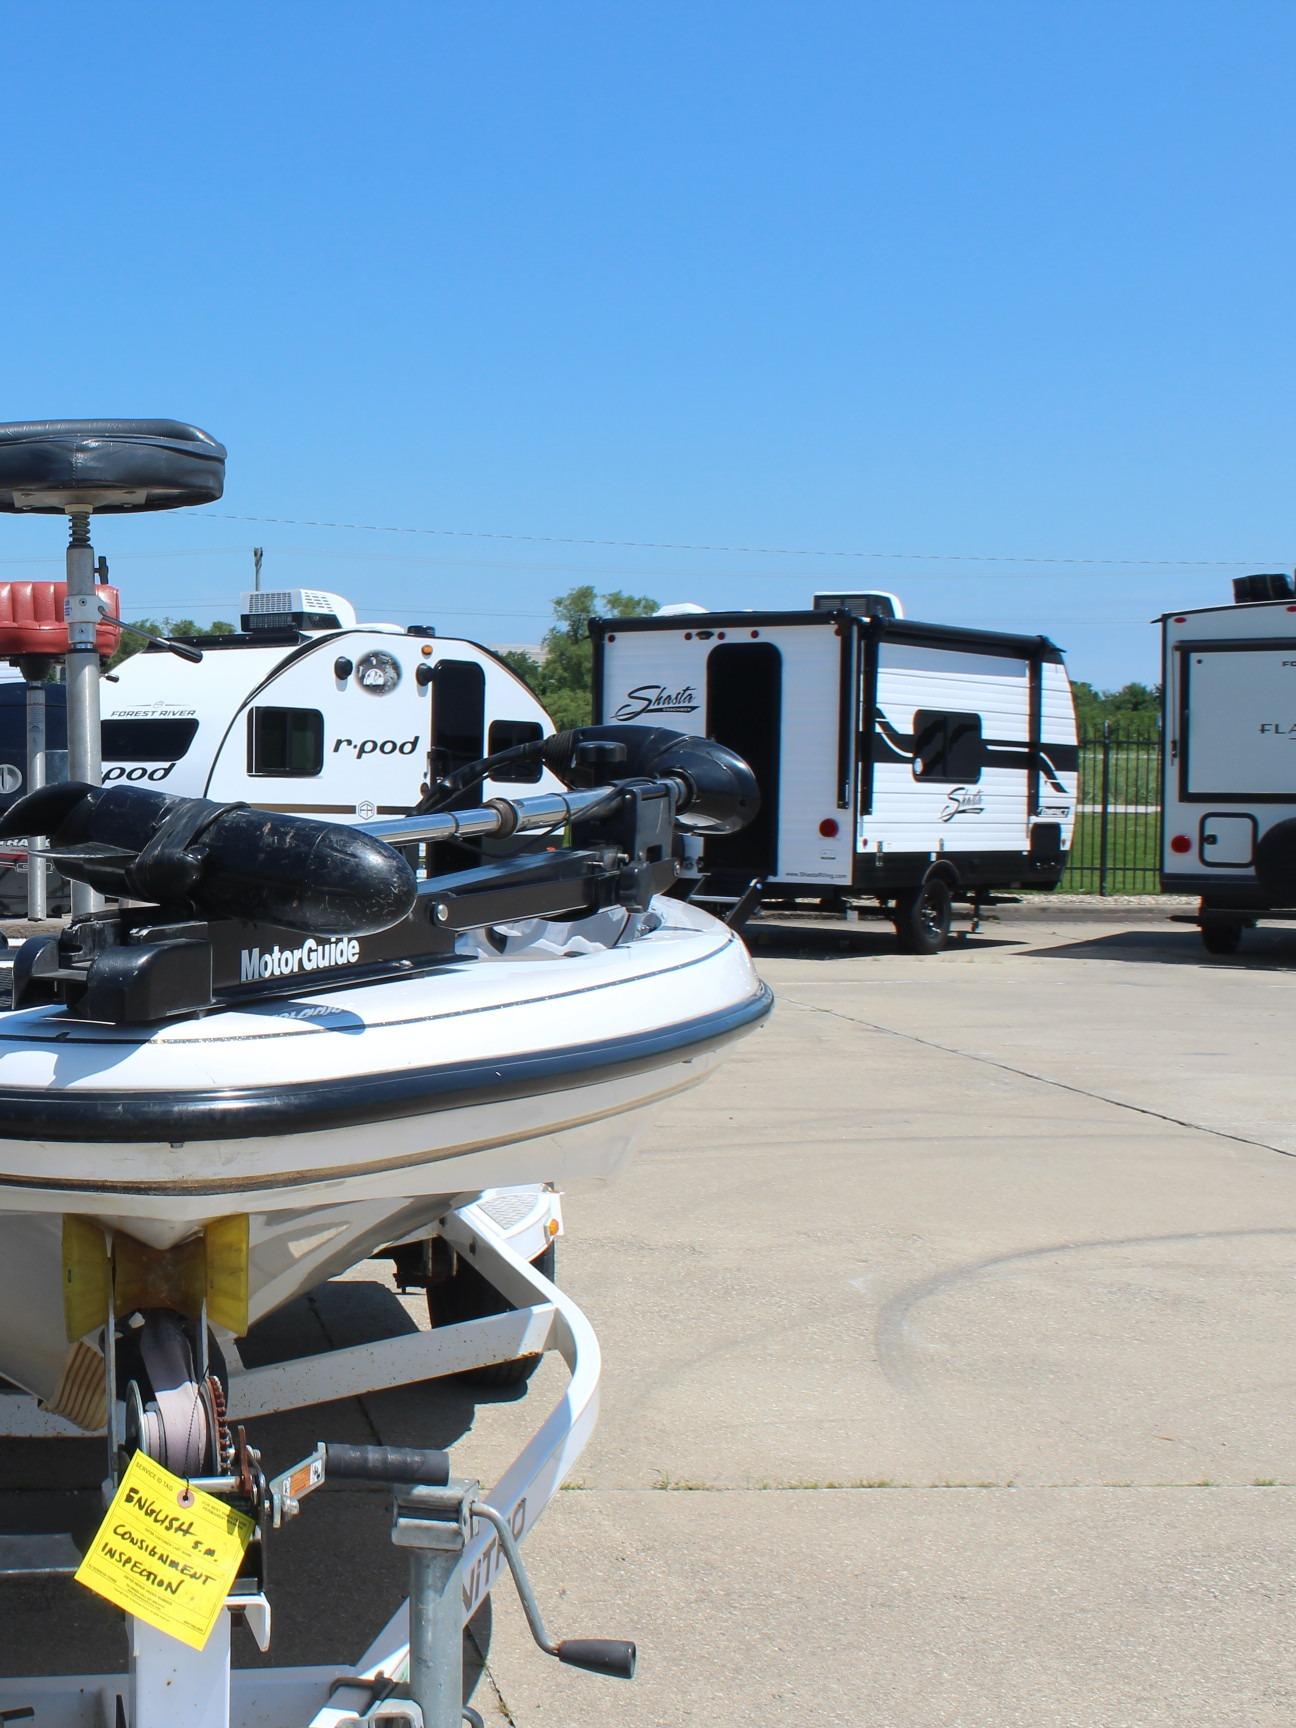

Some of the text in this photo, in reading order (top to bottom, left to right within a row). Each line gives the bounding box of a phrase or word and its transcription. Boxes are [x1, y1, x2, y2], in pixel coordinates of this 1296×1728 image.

[609, 685, 700, 722] Shasta
[240, 937, 360, 983] MotorGuide
[124, 1487, 197, 1537] ENGLISH
[101, 1542, 185, 1596] INSPECTION
[113, 1524, 217, 1586] CONSIGNMENT
